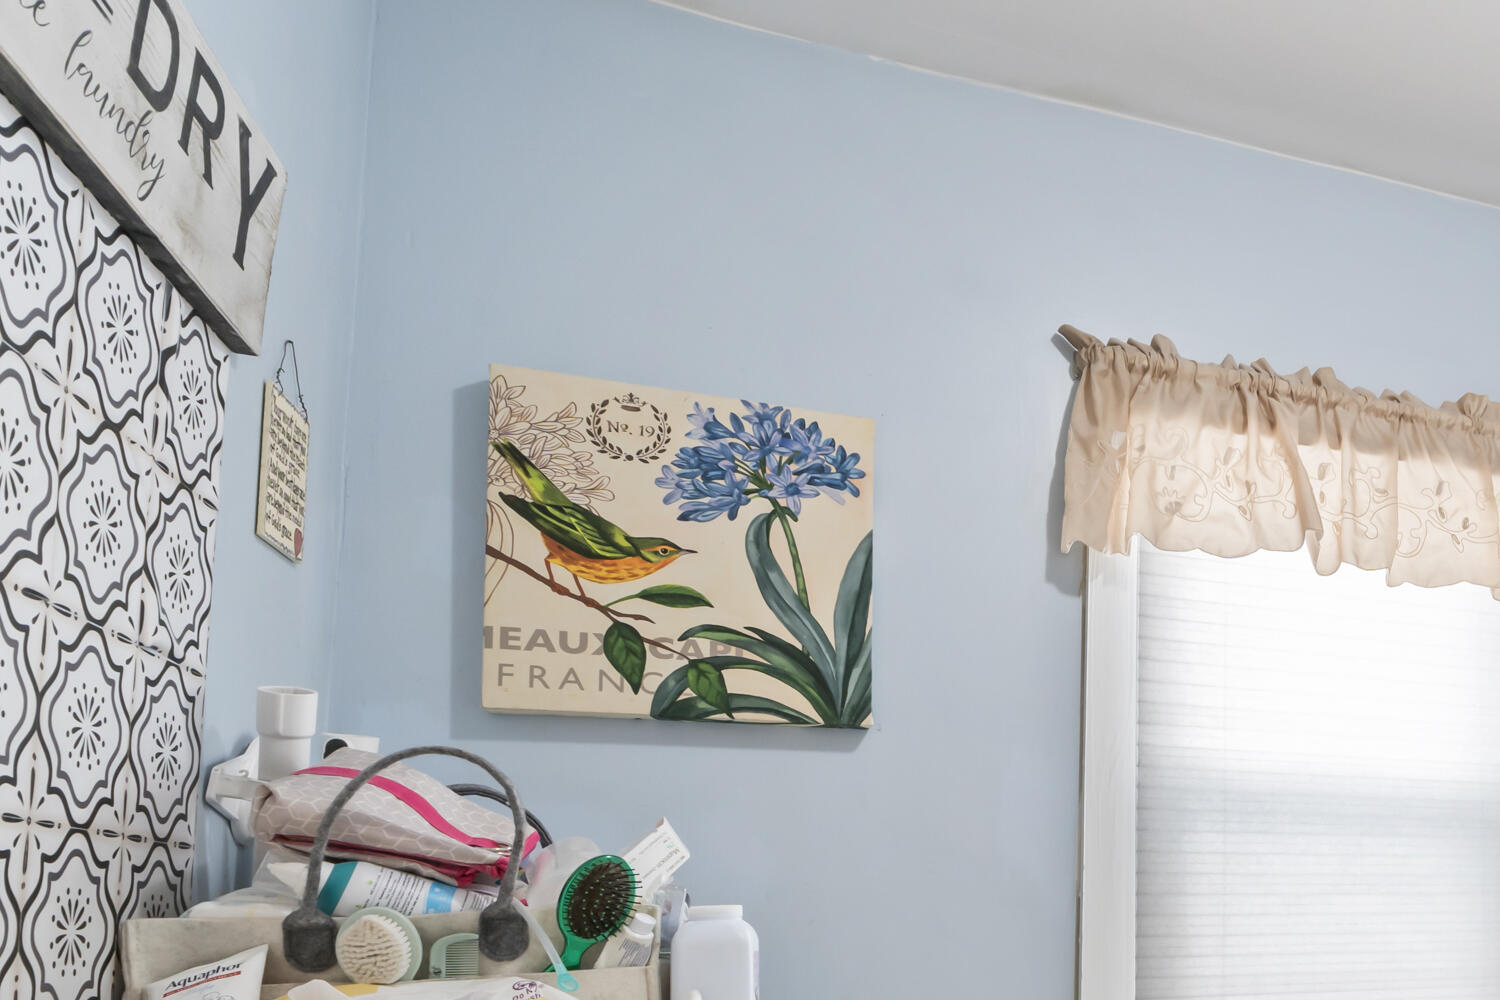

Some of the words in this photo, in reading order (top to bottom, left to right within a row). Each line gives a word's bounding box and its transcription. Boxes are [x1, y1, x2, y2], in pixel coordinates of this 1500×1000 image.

[64, 30, 166, 202] laundry
[126, 0, 278, 271] DRY
[639, 424, 656, 438] 19
[165, 961, 243, 991] Aquaphor
